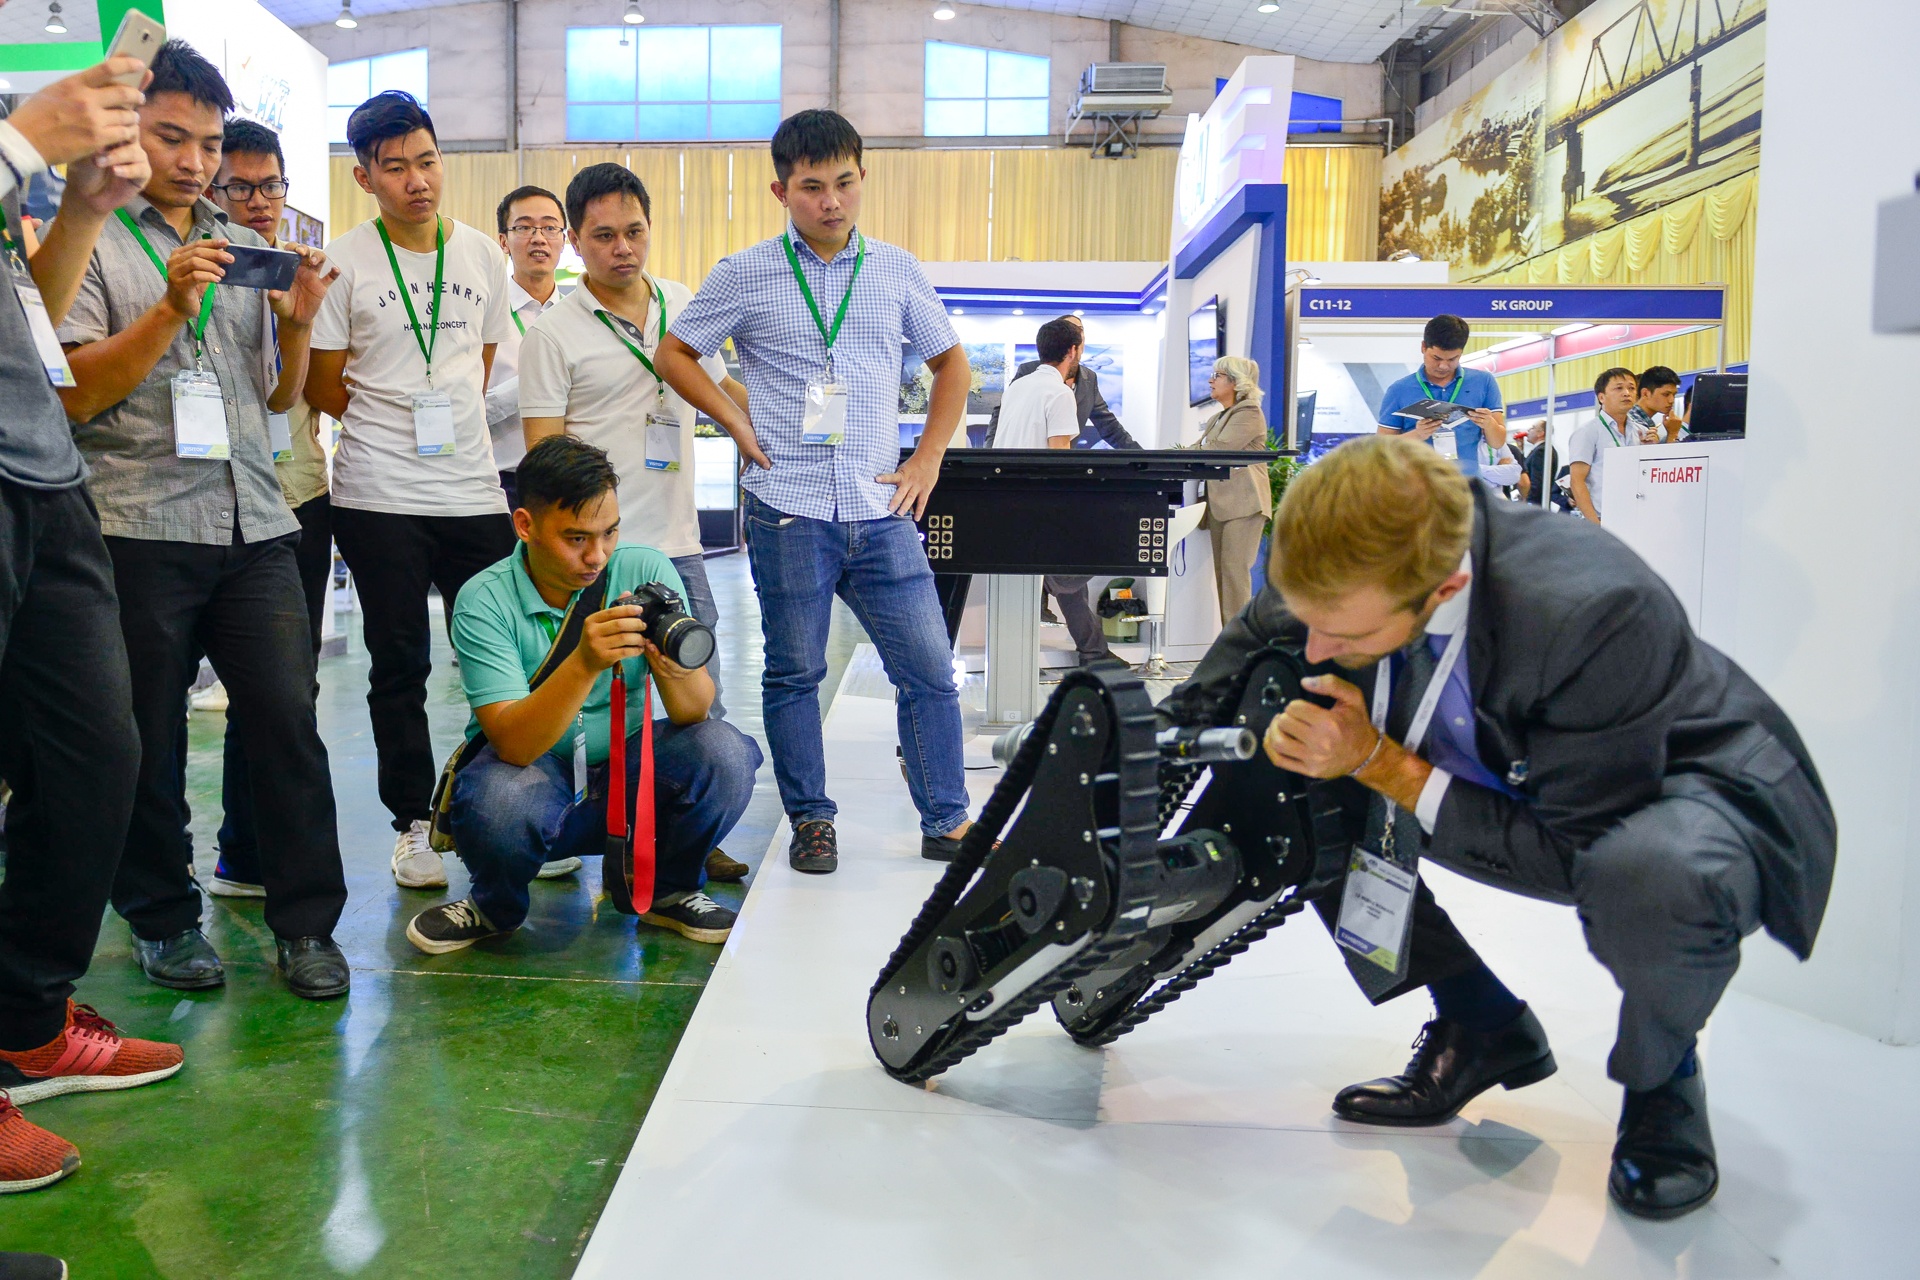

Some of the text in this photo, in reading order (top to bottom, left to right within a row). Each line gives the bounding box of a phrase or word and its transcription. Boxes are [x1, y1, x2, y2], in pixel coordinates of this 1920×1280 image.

[379, 281, 482, 308] JON HENRY
[425, 301, 434, 315] &
[1309, 299, 1352, 310] C11-12
[1491, 300, 1553, 311] SK GROUP
[403, 321, 467, 331] HAANA CONCEPT
[1650, 466, 1702, 483] FindART
